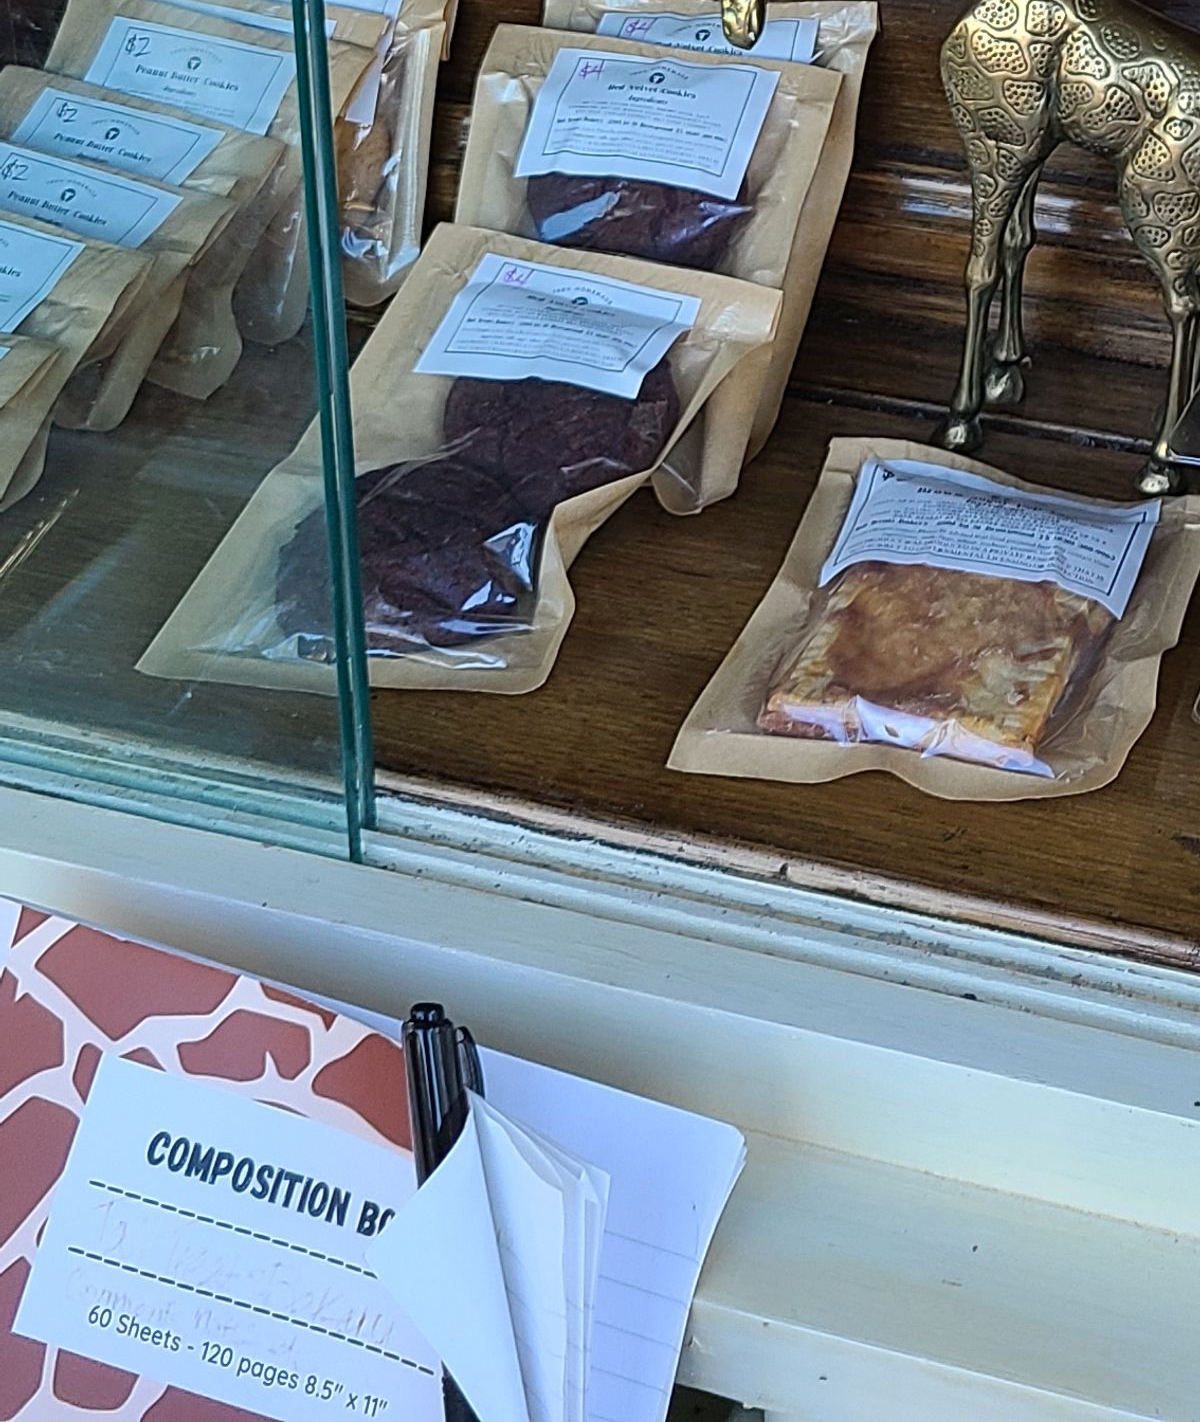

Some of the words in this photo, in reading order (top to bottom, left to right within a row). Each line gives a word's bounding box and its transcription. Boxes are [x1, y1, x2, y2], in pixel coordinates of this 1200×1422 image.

[125, 34, 151, 56] $2
[135, 62, 169, 79] Peanut
[171, 69, 201, 84] Butter
[203, 76, 240, 92] Cookies
[57, 102, 78, 123] $2
[86, 139, 116, 154] Butter
[118, 147, 152, 164] Cookies
[1, 159, 29, 181] $2
[7, 190, 40, 207] Peanut
[41, 199, 70, 215] Butter
[73, 209, 108, 226] Cookies
[147, 1130, 352, 1227] COMPOSITION
[87, 1304, 113, 1328] 60
[115, 1313, 181, 1353] Sheets
[200, 1340, 234, 1368] 120
[235, 1354, 300, 1390] pages
[304, 1374, 344, 1400] 8.5"
[346, 1392, 357, 1409] x
